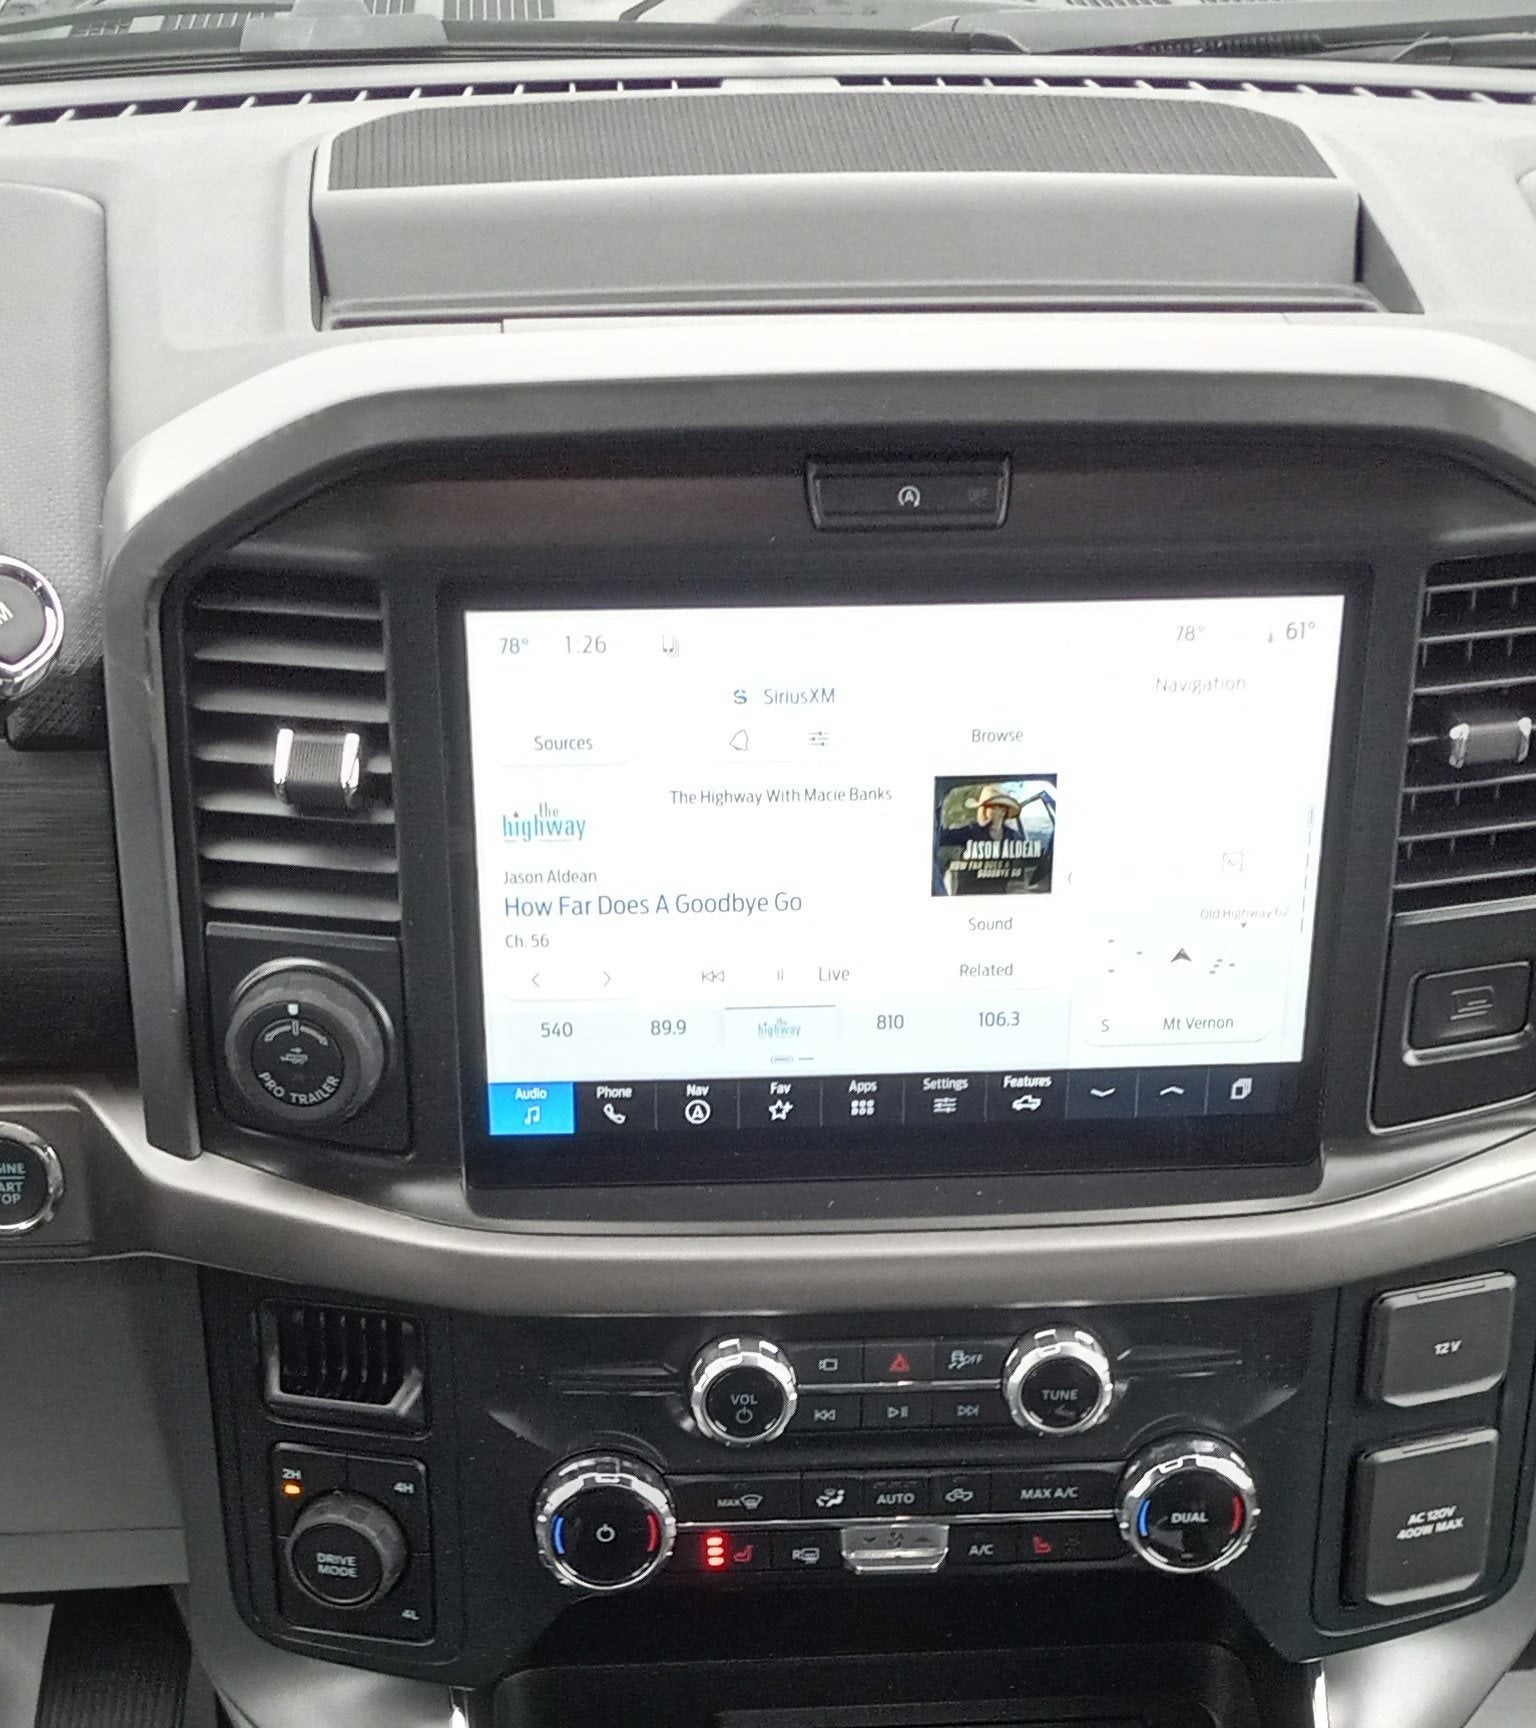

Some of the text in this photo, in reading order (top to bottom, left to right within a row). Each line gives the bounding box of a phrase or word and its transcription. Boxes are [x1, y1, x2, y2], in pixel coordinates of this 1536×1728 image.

[565, 635, 607, 653] 1:26
[1156, 677, 1246, 695] Navigation
[764, 687, 835, 705] SiriusXM
[534, 735, 593, 751] Sources
[971, 728, 1024, 743] Browse
[670, 787, 892, 806] The Highway With Macie Banks
[539, 802, 559, 817] the
[502, 812, 586, 842] highway
[962, 839, 1002, 860] JASON
[504, 870, 597, 885] Jason Aldean
[504, 892, 802, 917] How Far Does A Goodbye Go
[968, 917, 1013, 931] Sound
[505, 934, 550, 949] Ch. 56
[818, 967, 850, 982] Live
[959, 963, 1014, 978] Related
[876, 1014, 904, 1030] 810
[978, 1011, 1021, 1028] 106.3
[1101, 1019, 1110, 1033] S
[1163, 1016, 1234, 1031] Mt Vernon
[541, 1022, 573, 1038] 540
[650, 1019, 687, 1036] 89.9
[757, 1022, 802, 1038] highway
[258, 1072, 340, 1105] PRO TRAILER
[770, 1082, 792, 1095] Fav
[848, 1080, 877, 1095] Apps
[922, 1077, 969, 1092] Settings
[1002, 1075, 1052, 1089] Features
[515, 1087, 548, 1101] Audio
[596, 1086, 633, 1099] Phone
[686, 1084, 709, 1096] Nav
[730, 1394, 758, 1406] VOL
[1042, 1389, 1079, 1400] TUNE
[282, 1468, 302, 1480] 2H
[393, 1482, 414, 1494] 4H
[1020, 1487, 1079, 1500] MAX A/C
[717, 1499, 741, 1508] MAX
[876, 1493, 915, 1505] AUTO
[1171, 1512, 1209, 1524] DUAL
[1408, 1506, 1457, 1525] AC 120V
[1397, 1517, 1464, 1540] 400W MAX
[969, 1544, 994, 1555] A/C
[316, 1552, 357, 1567] DRIVE
[317, 1565, 358, 1578] MODE
[401, 1609, 420, 1621] 4L
